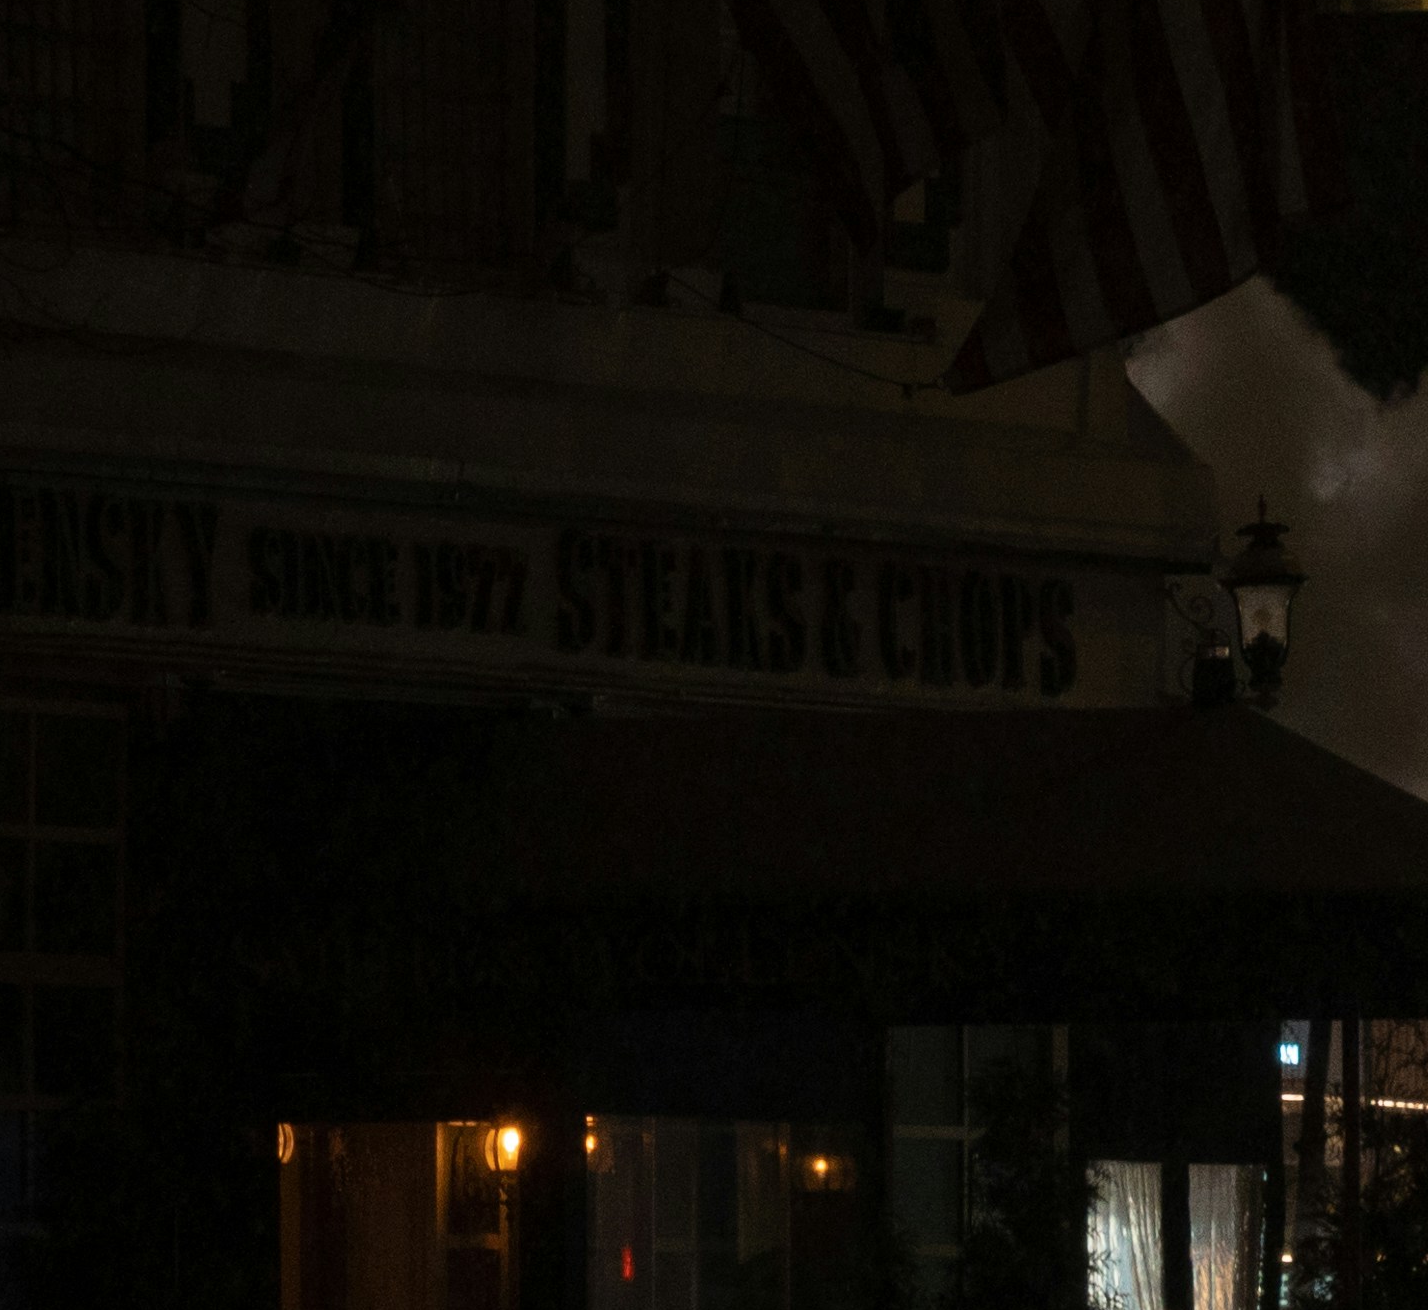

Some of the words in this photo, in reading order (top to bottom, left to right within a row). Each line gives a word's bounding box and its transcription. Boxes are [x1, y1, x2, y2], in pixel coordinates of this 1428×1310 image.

[248, 525, 402, 625] SINCE
[413, 540, 527, 637] 1977
[555, 526, 804, 674] STEAKS
[821, 558, 862, 678] &
[876, 561, 1078, 697] CHOPS
